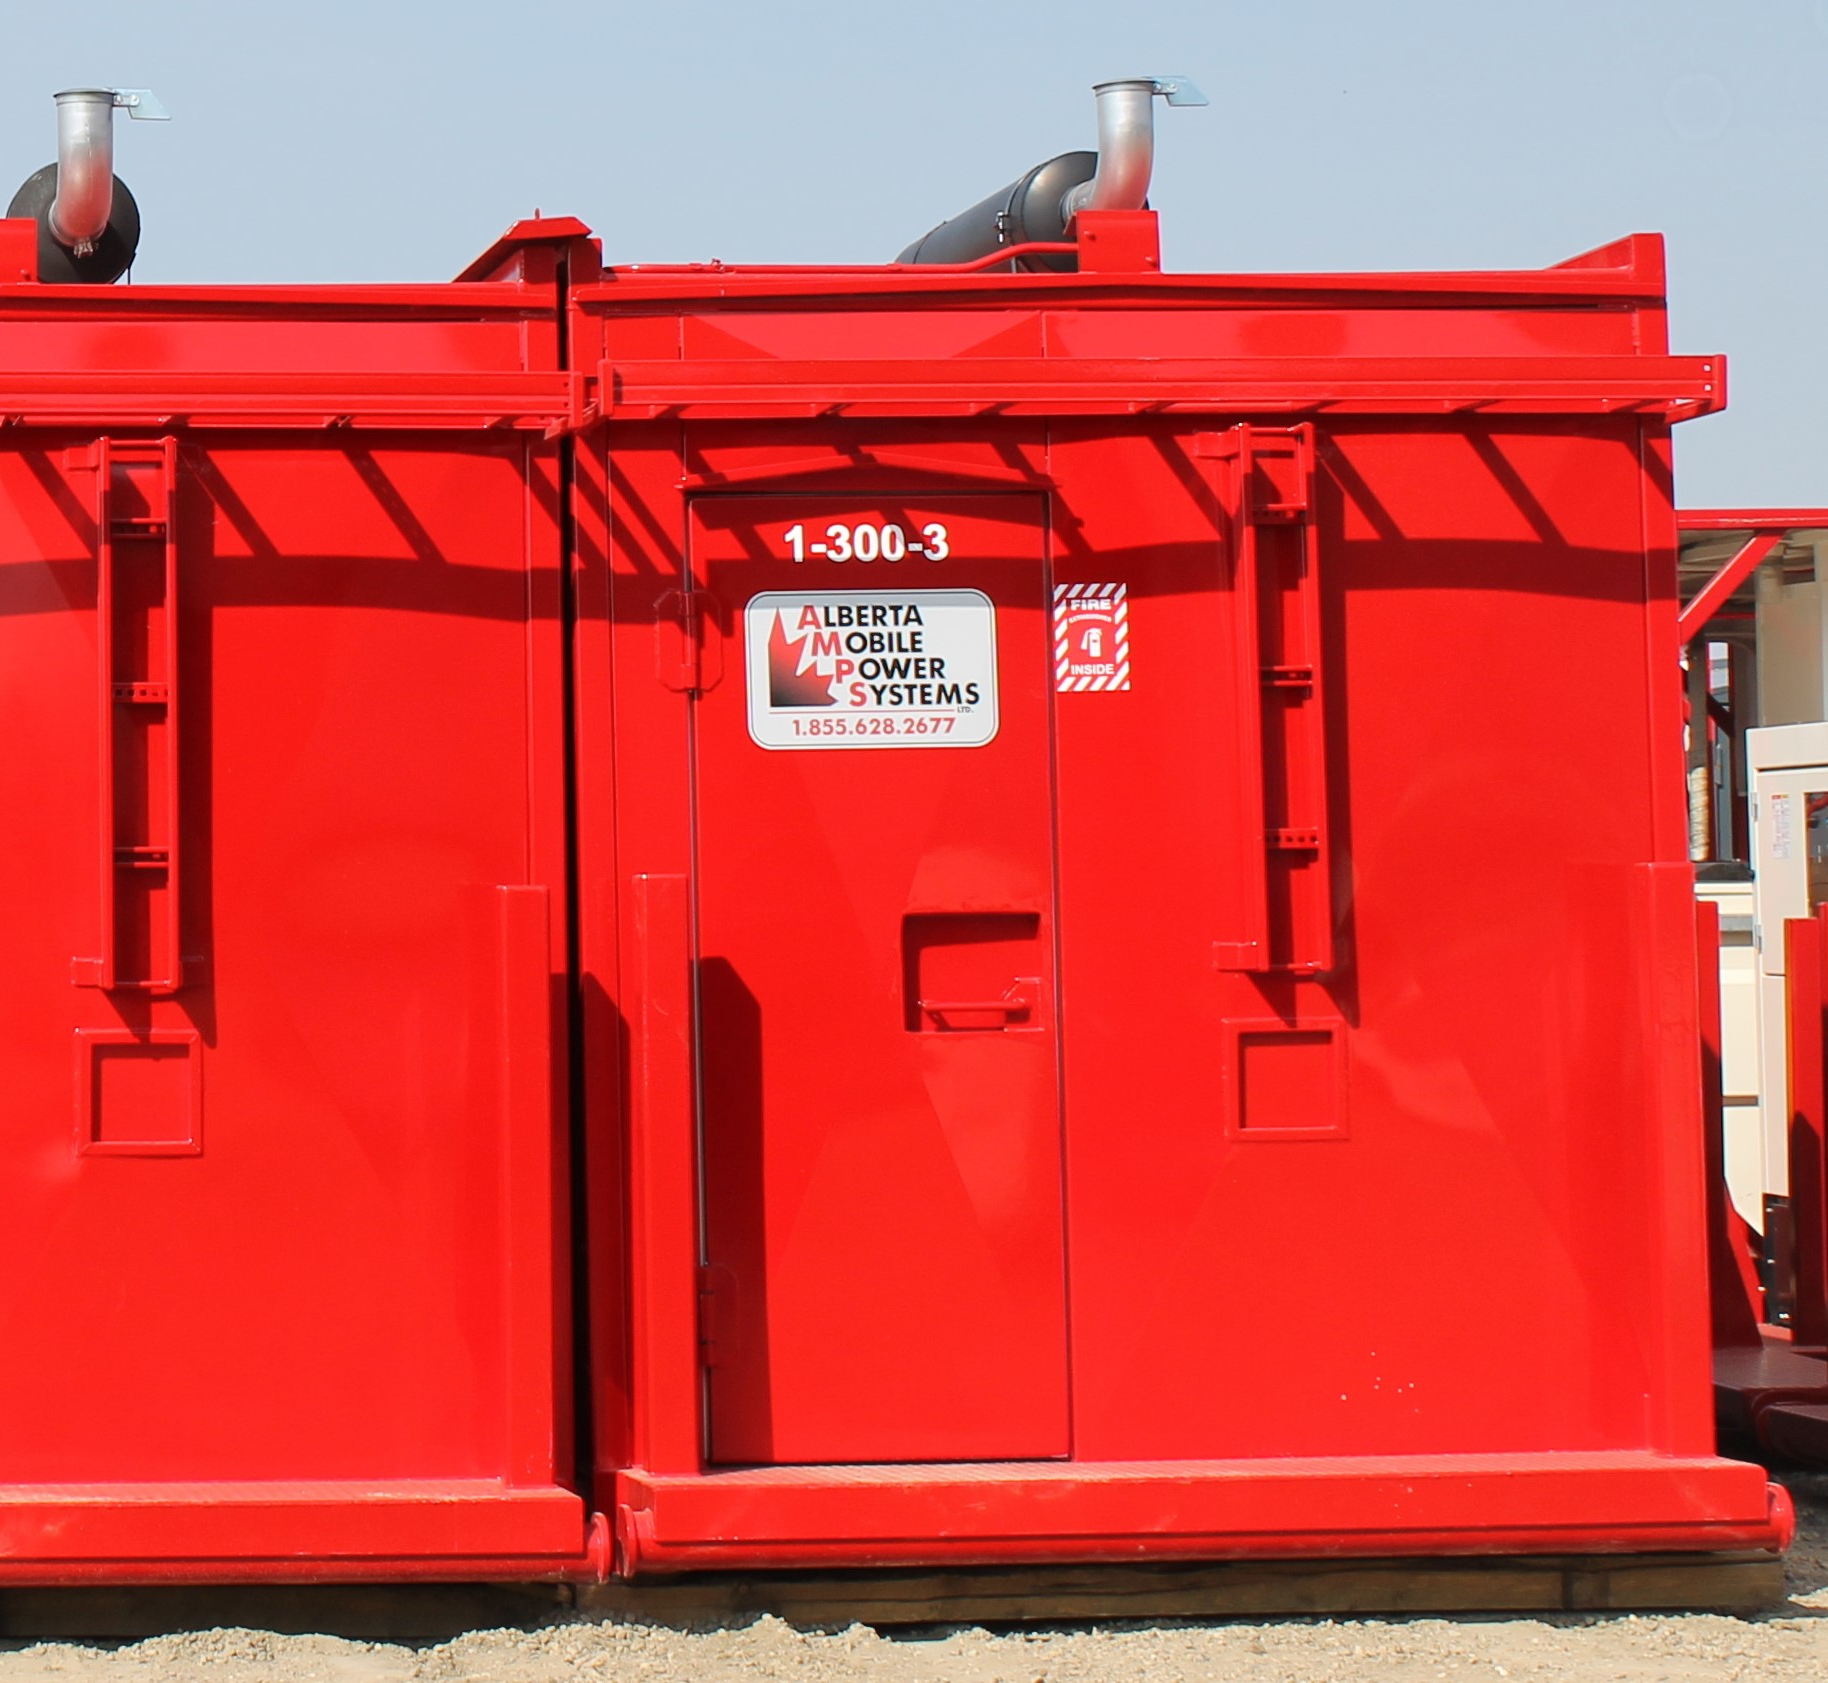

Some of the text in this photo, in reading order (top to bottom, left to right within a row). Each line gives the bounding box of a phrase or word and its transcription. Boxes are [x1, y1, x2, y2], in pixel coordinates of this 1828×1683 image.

[783, 523, 950, 563] 1-300-3
[797, 604, 924, 630] ALBERTA
[1070, 599, 1113, 611] FIRE
[811, 631, 923, 657] MOBILE
[834, 657, 946, 684] POWER
[1070, 664, 1115, 676] INSIDE
[849, 681, 980, 708] SYSTEMS
[792, 717, 956, 736] 1.855.628.2677
